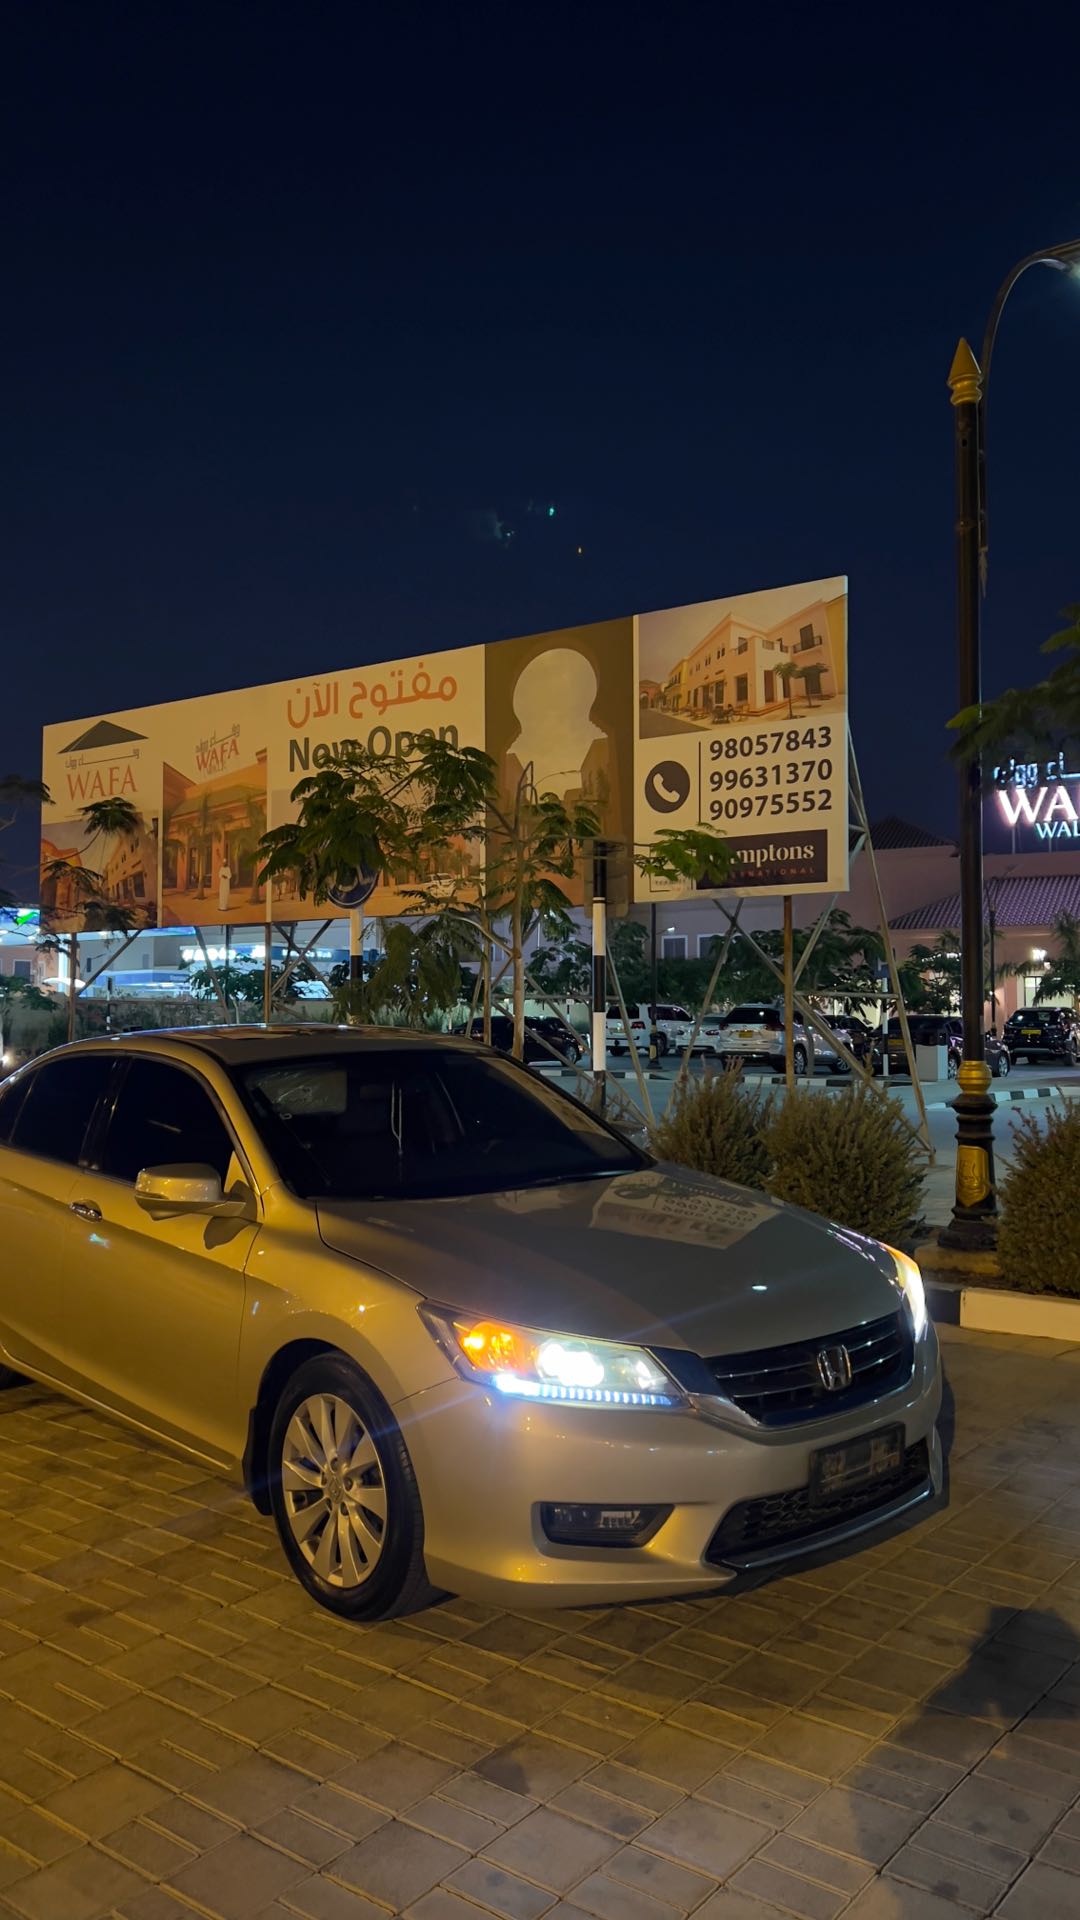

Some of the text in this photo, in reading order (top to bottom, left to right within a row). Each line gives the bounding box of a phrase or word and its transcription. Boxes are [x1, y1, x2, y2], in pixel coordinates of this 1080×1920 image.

[287, 662, 458, 729] مفتوح الآن
[195, 737, 240, 772] WAFA
[367, 724, 459, 767] Open
[709, 726, 832, 761] 98057843
[66, 763, 138, 801] WAFA
[709, 758, 833, 793] 99631370
[709, 789, 833, 821] 90975552
[995, 784, 1080, 827] WA
[729, 844, 815, 868] mptons
